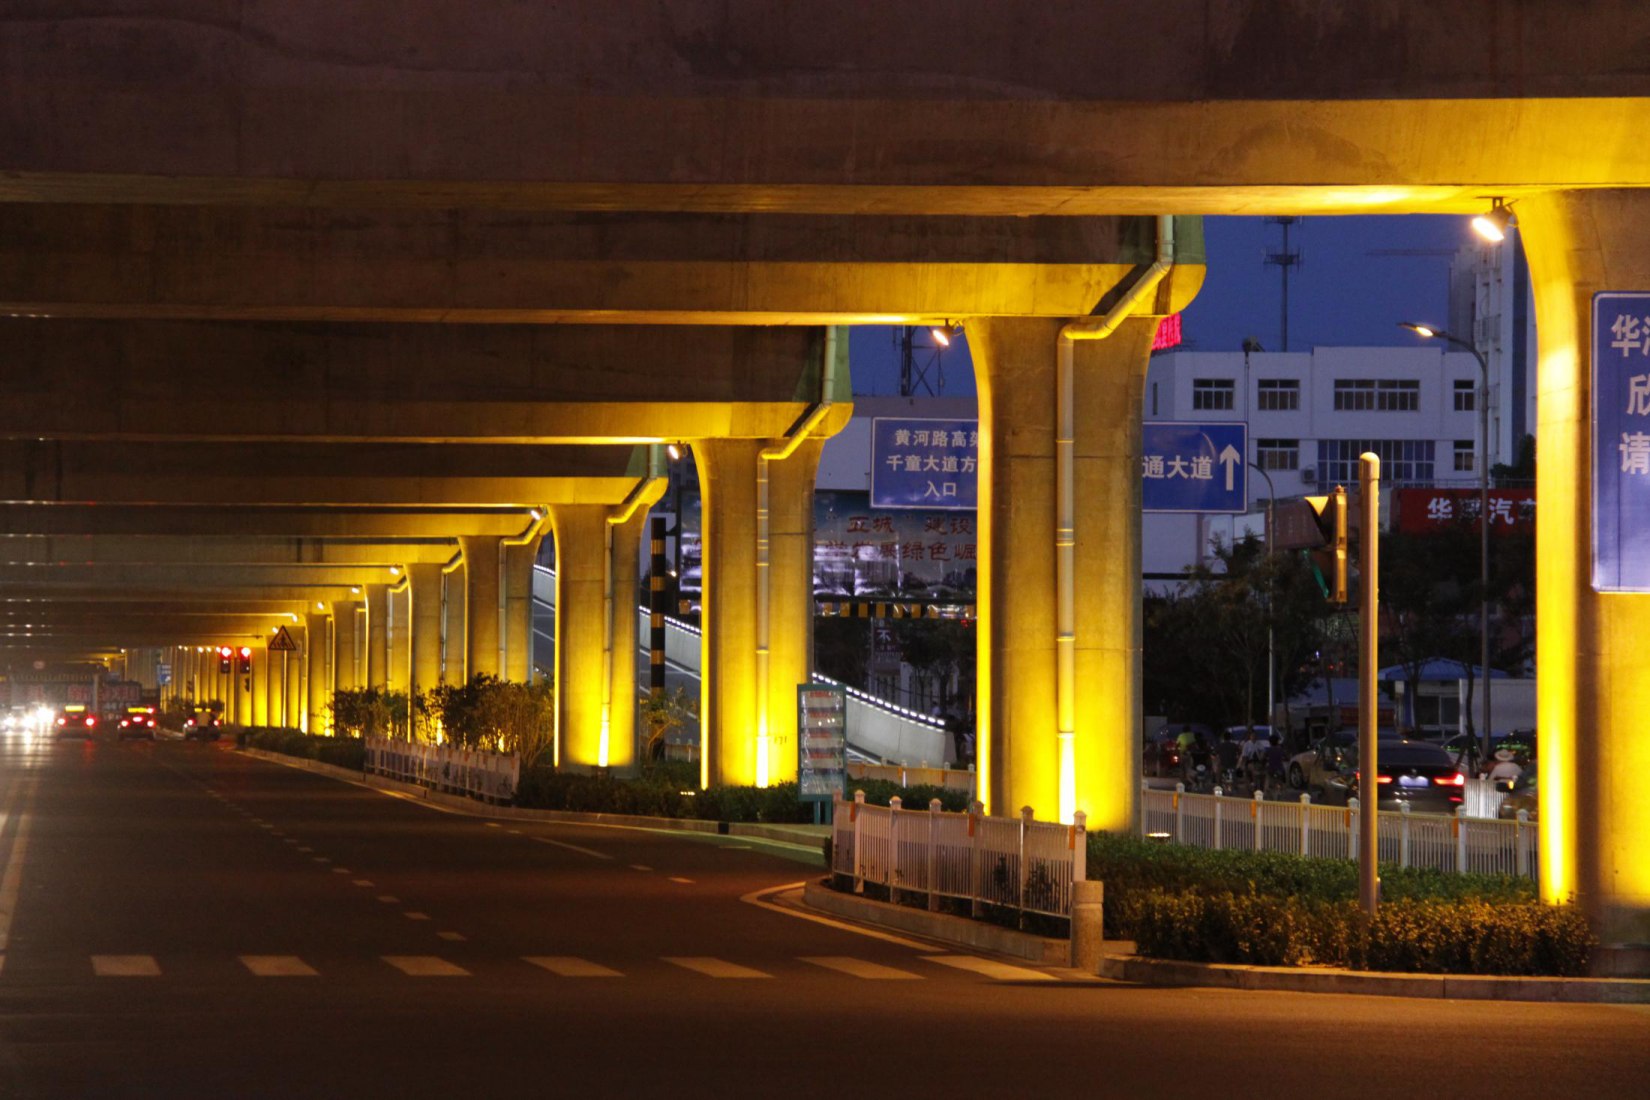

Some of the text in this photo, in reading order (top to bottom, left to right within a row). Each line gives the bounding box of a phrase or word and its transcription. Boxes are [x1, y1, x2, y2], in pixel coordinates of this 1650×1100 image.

[1611, 314, 1650, 357] 华
[886, 455, 976, 473] 千童大道方
[1141, 455, 1213, 479] 通大道
[924, 481, 957, 498] 入口
